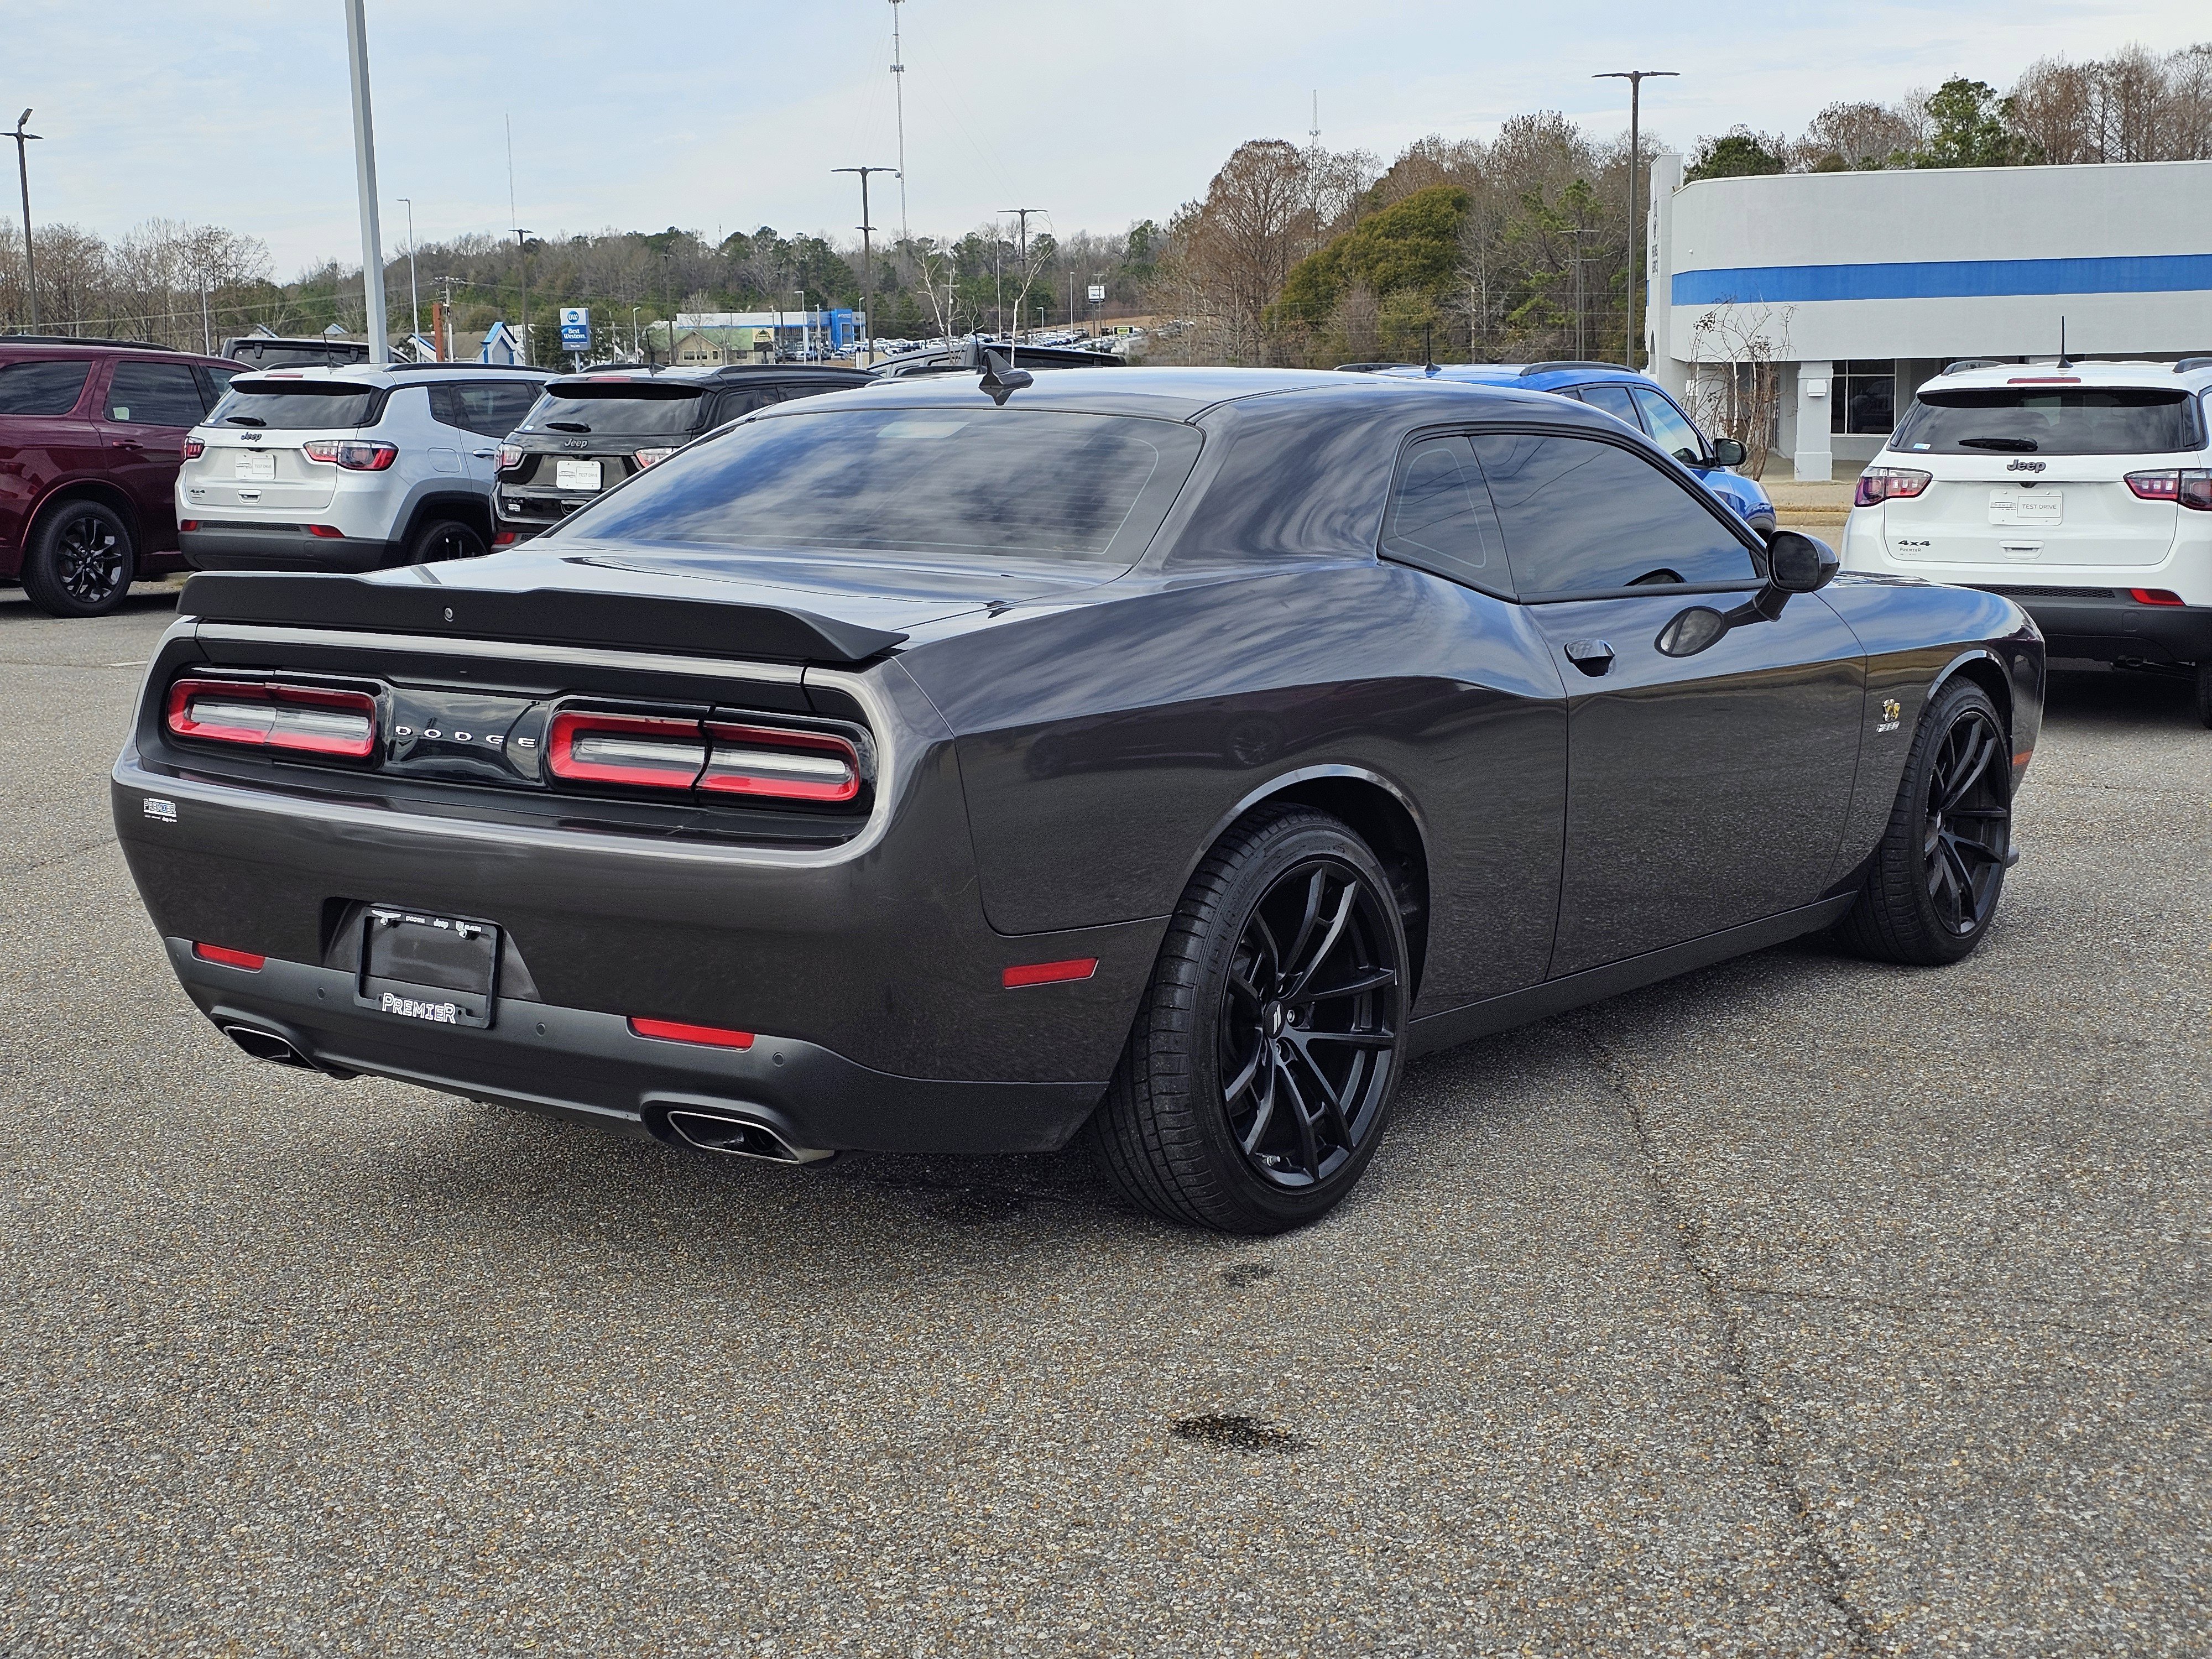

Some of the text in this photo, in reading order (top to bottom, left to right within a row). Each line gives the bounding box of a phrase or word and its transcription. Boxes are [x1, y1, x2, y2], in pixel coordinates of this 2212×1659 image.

[241, 431, 263, 442] Jeep
[564, 438, 588, 448] Jeep
[2006, 459, 2047, 474] Jeep
[395, 726, 536, 748] DODGE
[143, 798, 176, 815] PREMIER
[382, 992, 456, 1024] PREMIER
